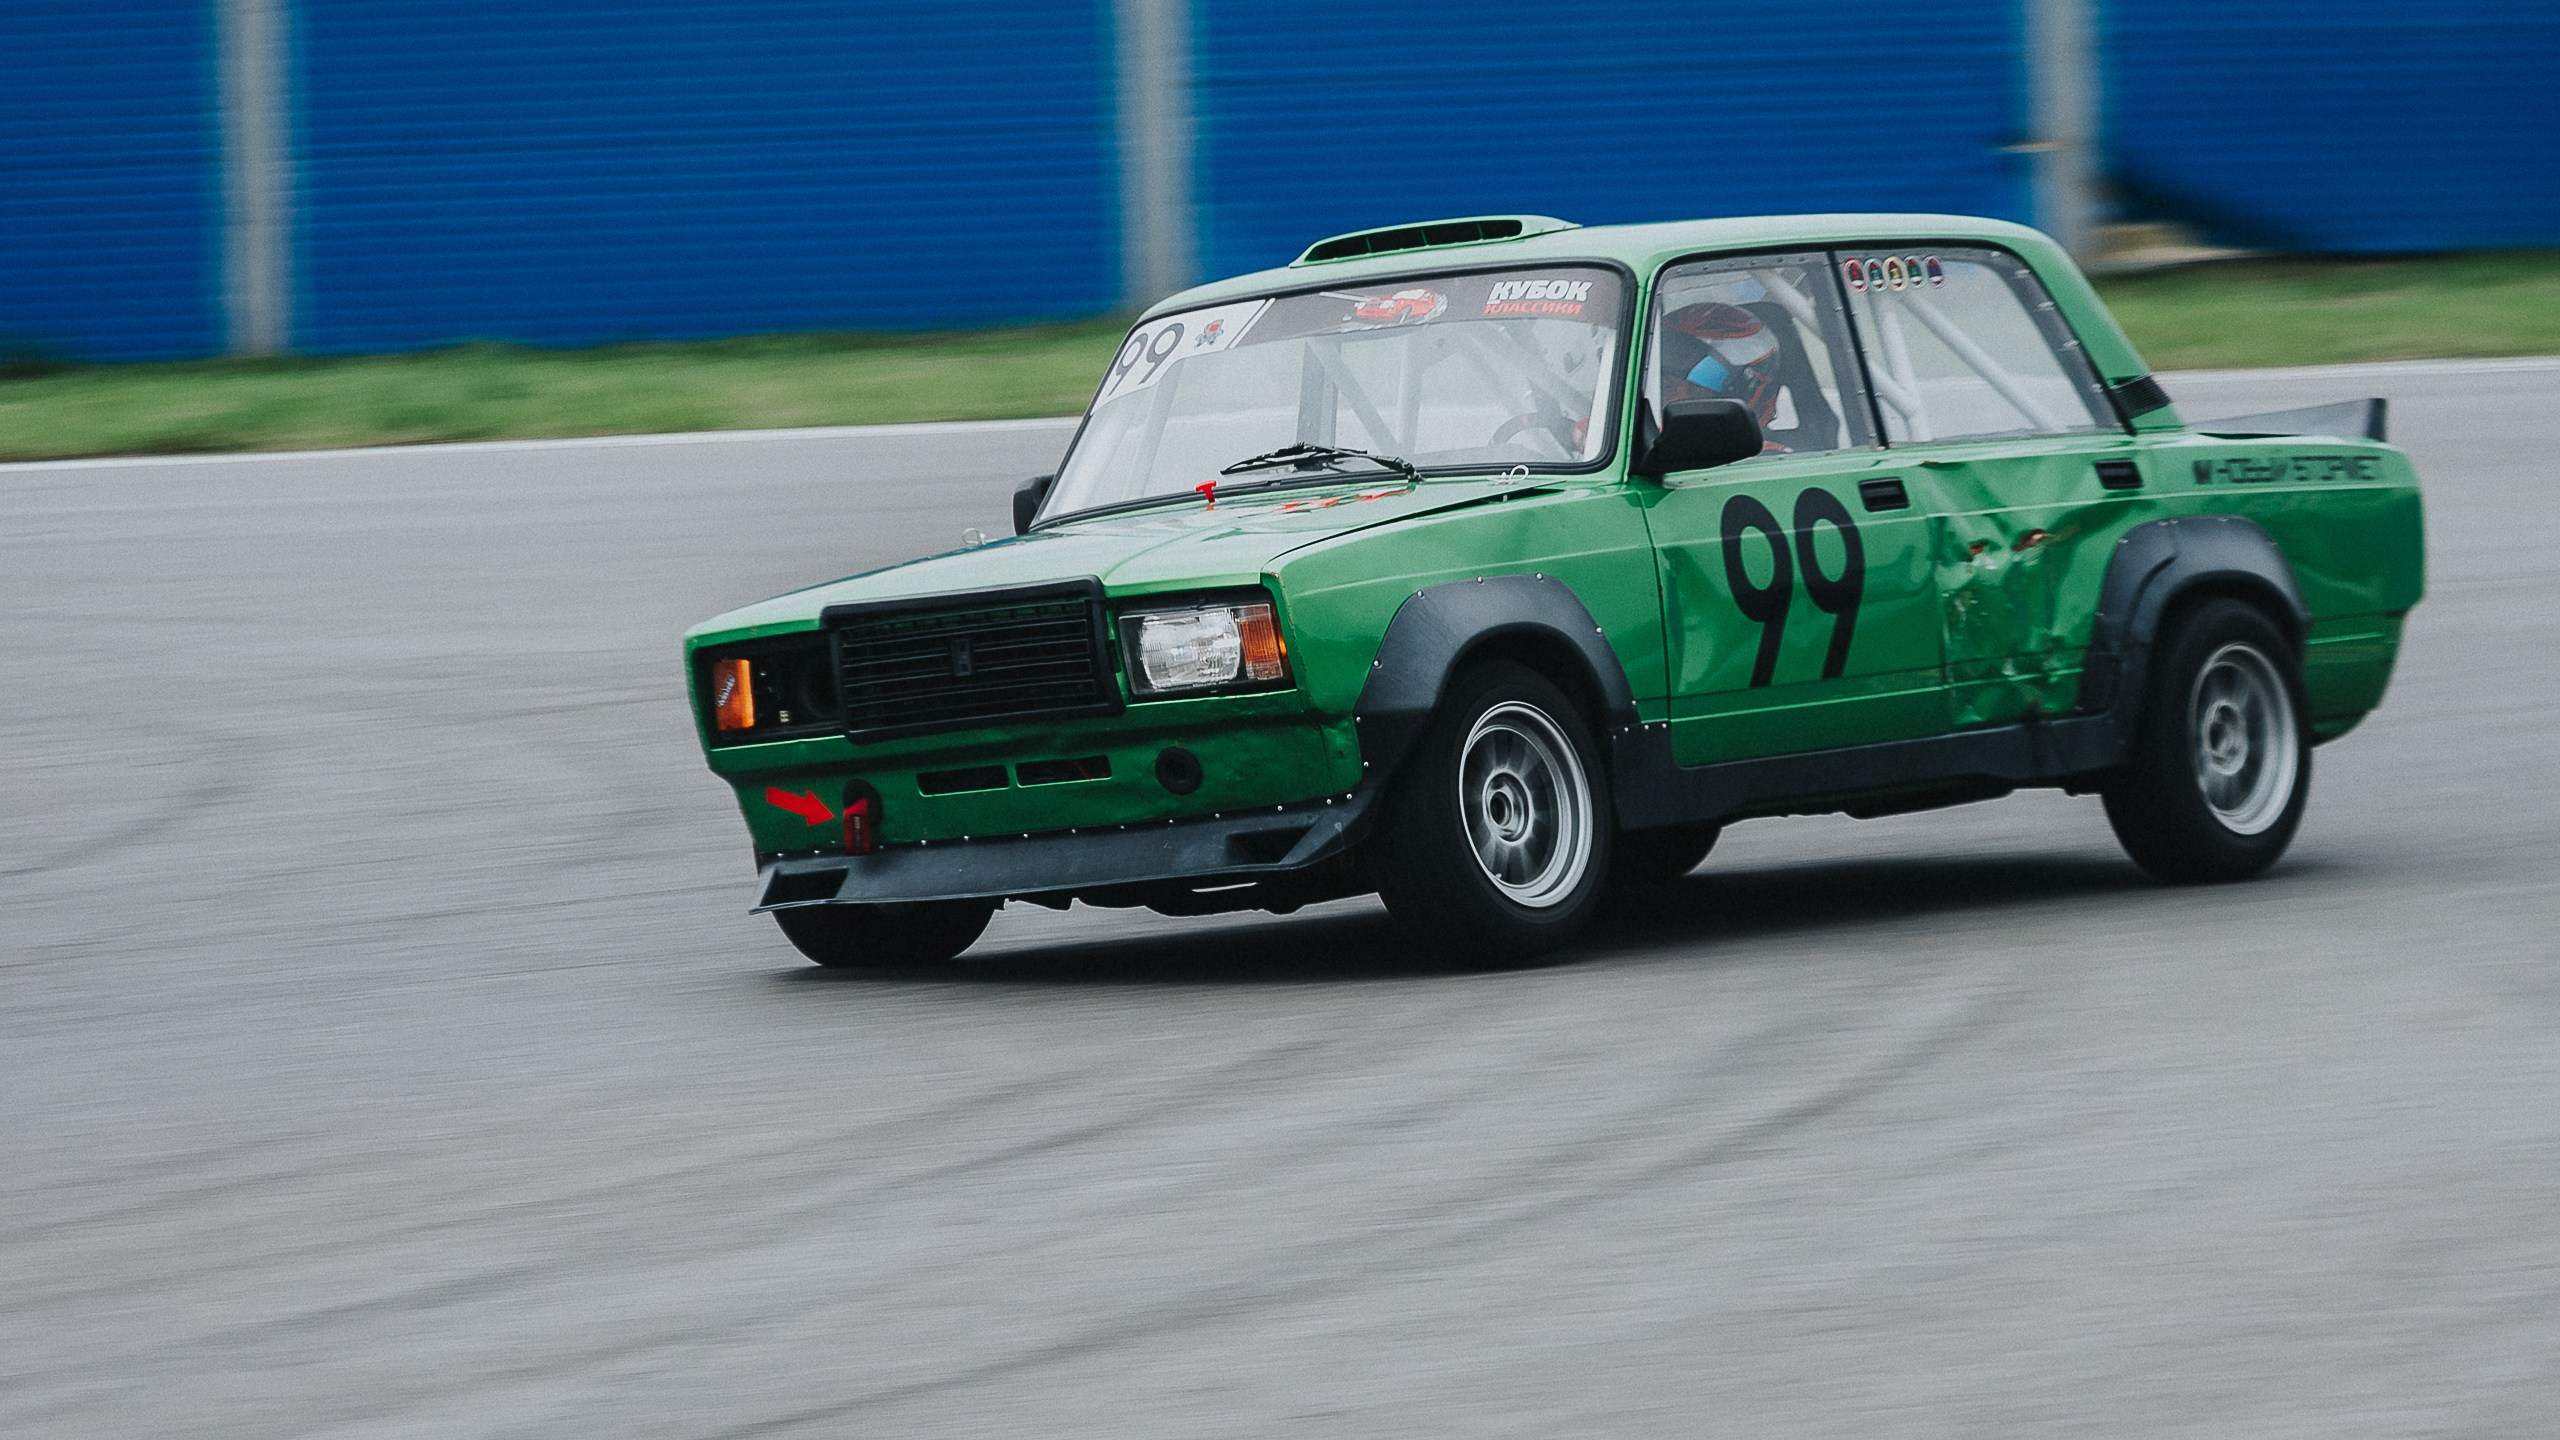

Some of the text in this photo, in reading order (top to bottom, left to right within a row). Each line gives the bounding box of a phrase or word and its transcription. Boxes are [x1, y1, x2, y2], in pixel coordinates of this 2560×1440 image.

[1483, 302, 1584, 317] КЛАССИКИ
[1486, 280, 1593, 305] КУБОК
[1106, 321, 1185, 397] 99
[1720, 486, 1866, 689] 99
